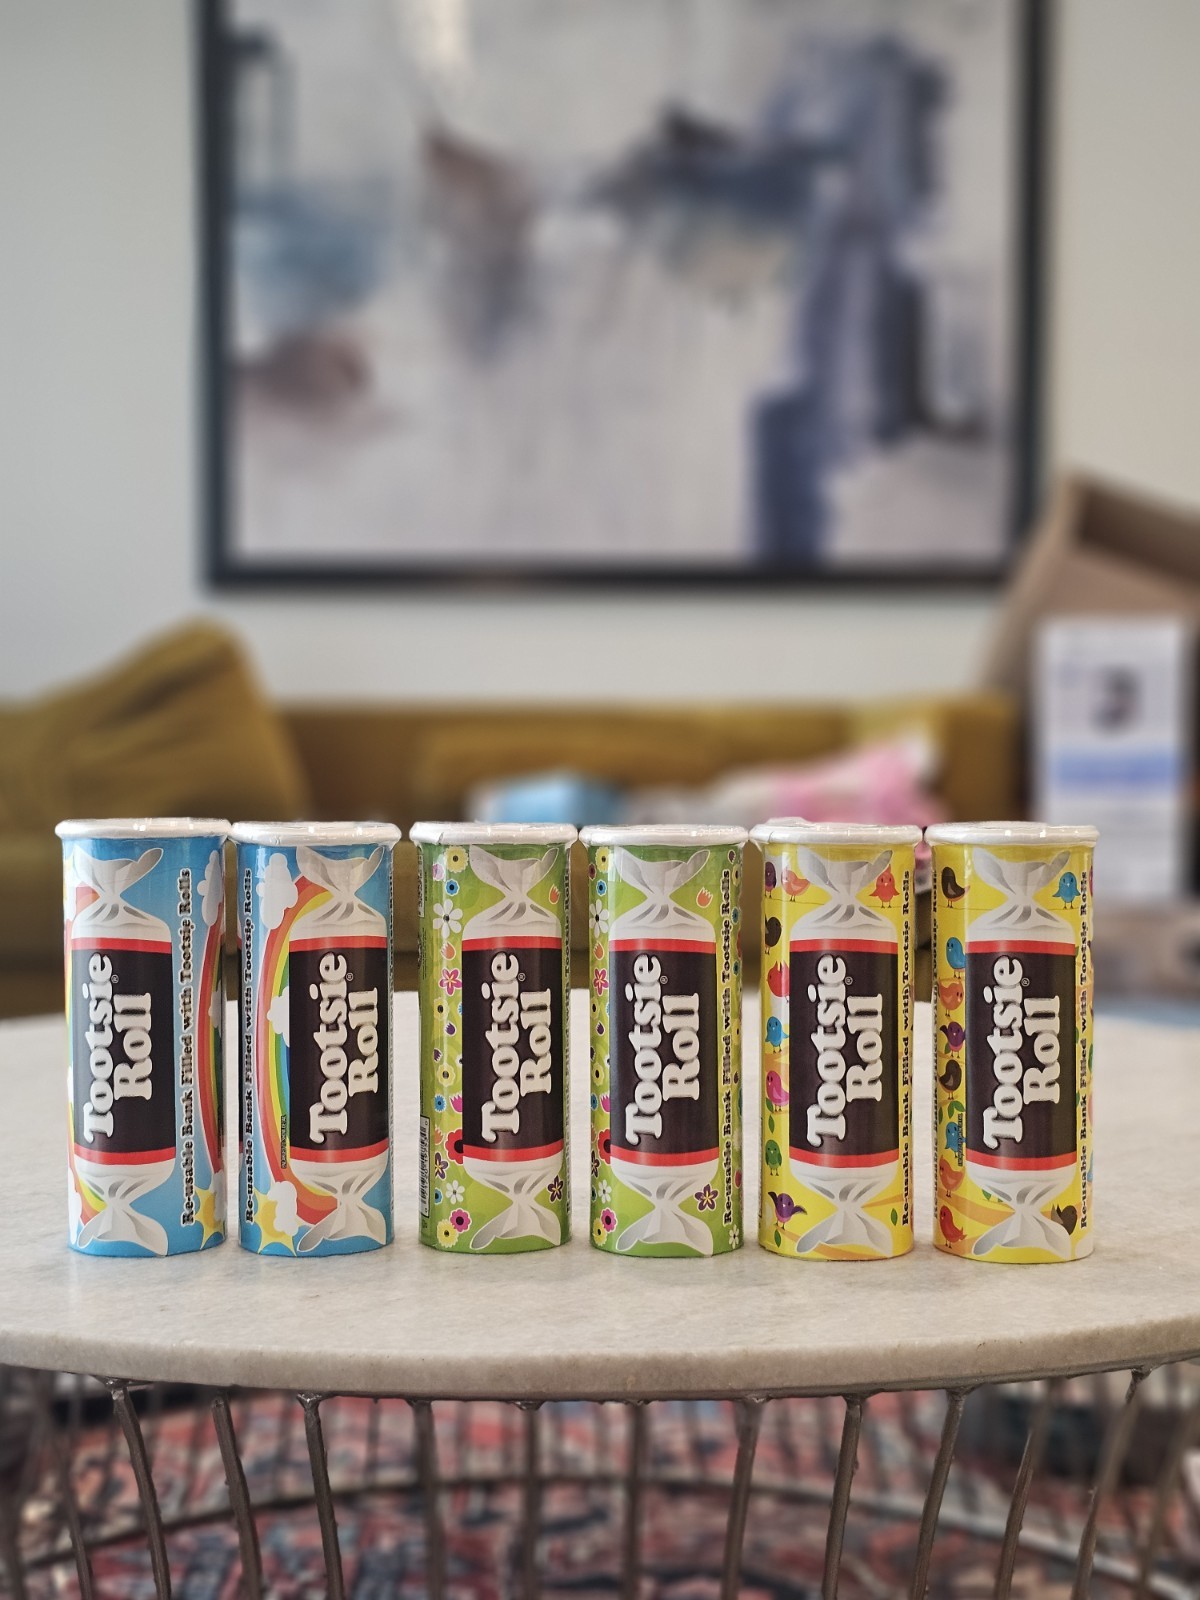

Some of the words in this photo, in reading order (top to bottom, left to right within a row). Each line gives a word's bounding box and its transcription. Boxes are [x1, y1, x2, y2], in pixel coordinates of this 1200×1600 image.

[178, 870, 190, 914] Rolls
[243, 869, 251, 914] Rolls
[721, 870, 729, 915] Rolls
[1079, 871, 1087, 916] Rolls
[180, 919, 194, 983] Tootsie
[243, 918, 253, 982] Tootsie
[721, 919, 732, 983] Tootsie
[902, 920, 910, 984] Tootsie
[1079, 921, 1088, 986] Tootsie
[180, 987, 192, 1030] with
[244, 987, 252, 1028] with
[722, 987, 730, 1030] with
[82, 952, 114, 1143] Tootsie
[113, 992, 152, 1101] Roll
[180, 1034, 193, 1085] Filled
[244, 1034, 252, 1083] Filled
[308, 952, 347, 1144] Tootsie
[348, 987, 378, 1097] Roll
[481, 952, 519, 1142] Tootsie
[519, 988, 551, 1097] Roll
[625, 954, 662, 1145] Tootsie
[661, 992, 699, 1102] Roll
[722, 1036, 730, 1086] Filled
[806, 954, 846, 1147] Tootsie
[846, 993, 882, 1103] Roll
[901, 1037, 909, 1086] Filled
[983, 956, 1023, 1150] Tootsie
[1023, 995, 1061, 1105] Roll
[181, 1090, 193, 1136] Bank
[245, 1089, 253, 1135] Bank
[723, 1090, 731, 1137] Bank
[901, 1091, 909, 1138] Bank
[182, 1142, 194, 1225] Re-usable
[245, 1140, 253, 1222] Re-usable
[723, 1141, 731, 1225] Re-usable
[901, 1142, 909, 1226] Re-usable
